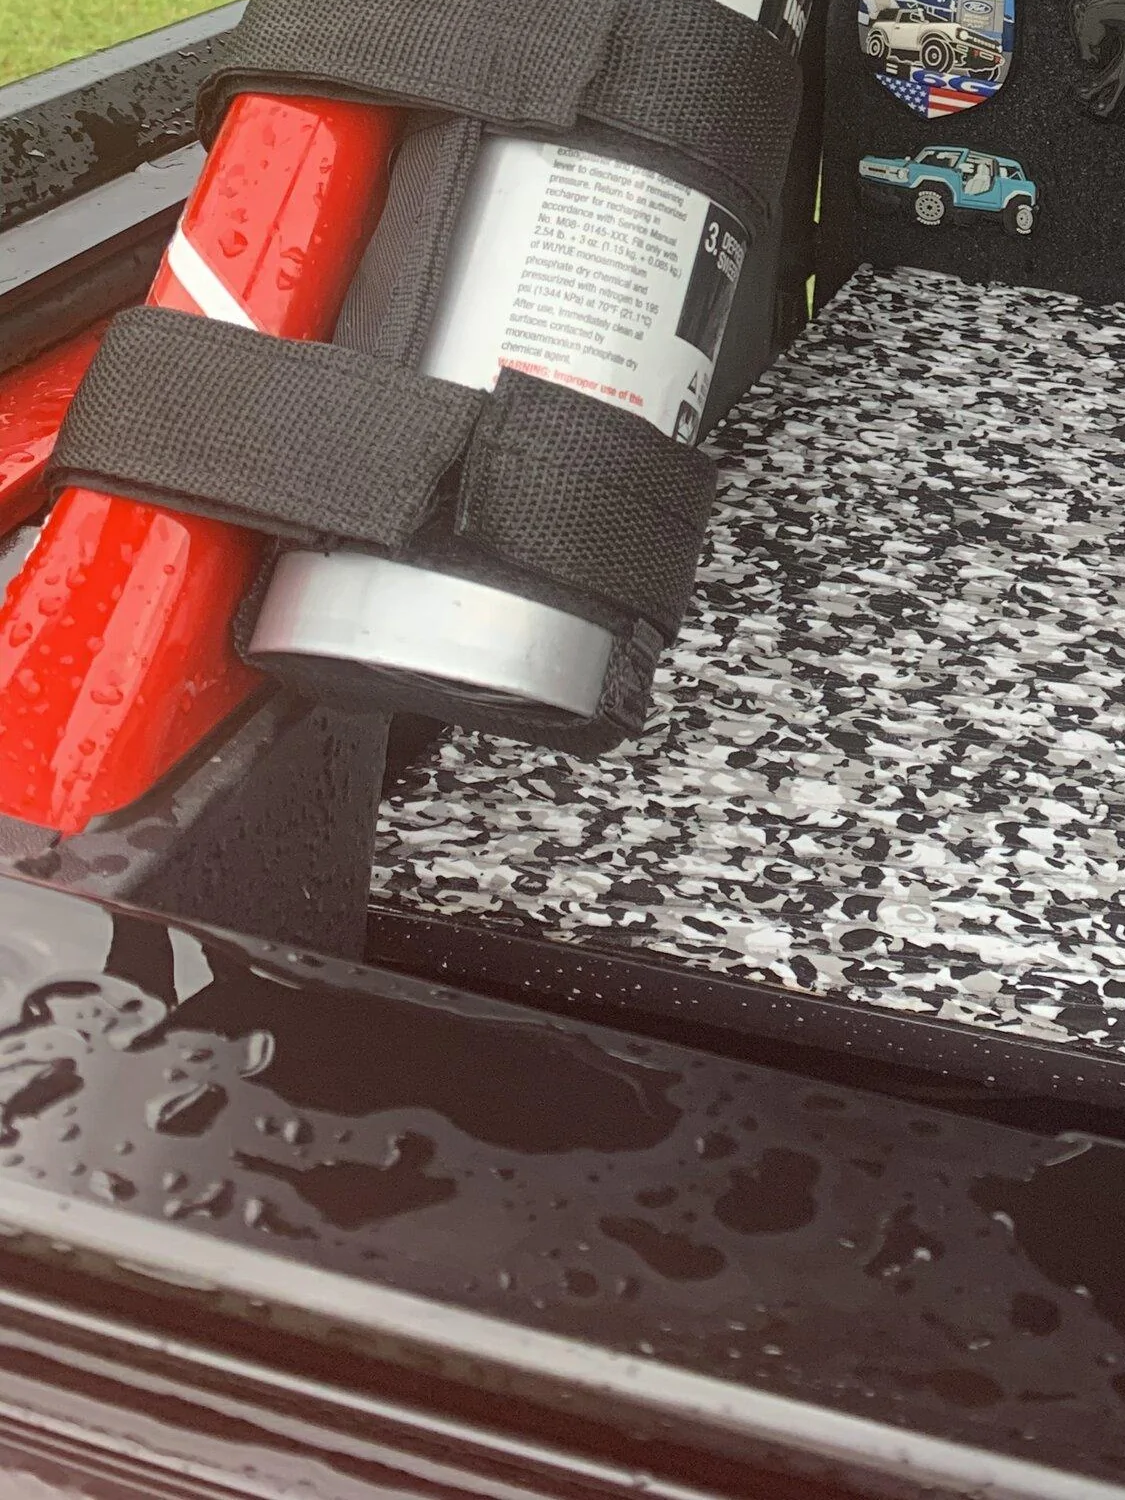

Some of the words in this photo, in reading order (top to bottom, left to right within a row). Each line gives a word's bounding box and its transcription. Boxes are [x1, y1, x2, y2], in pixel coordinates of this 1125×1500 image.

[553, 160, 575, 172] lever
[577, 164, 587, 174] to
[589, 167, 632, 186] discharge
[646, 184, 685, 207] remaining
[594, 181, 623, 197] Return
[626, 190, 634, 200] to
[636, 196, 647, 205] an
[648, 199, 688, 222] authorized
[542, 200, 594, 219] accordance
[596, 213, 616, 225] with
[618, 217, 648, 235] Service
[650, 228, 677, 247] Manual
[545, 187, 589, 203] recharger
[592, 196, 604, 207] for
[606, 200, 651, 224] recharging
[653, 215, 661, 225] in
[534, 225, 554, 237] 2.54
[579, 234, 585, 243] 3
[645, 243, 661, 255] only
[663, 249, 678, 262] with
[704, 222, 720, 256] 3.
[525, 254, 573, 273] phosphate
[576, 265, 590, 277] dry
[593, 269, 632, 289] chemical
[633, 283, 648, 295] and
[530, 241, 540, 249] of
[576, 250, 647, 278] monoammonium
[517, 282, 532, 294] psi
[534, 285, 561, 298] (1344
[564, 291, 584, 307] kPa)
[586, 296, 595, 306] at
[521, 269, 575, 288] pressurized
[577, 280, 596, 293] with
[599, 285, 635, 306] nitrogen
[636, 297, 643, 308] to
[509, 313, 548, 328] surfaces
[550, 321, 593, 341] contacted
[594, 332, 606, 345] by
[512, 297, 534, 310] After
[612, 323, 633, 337] clean
[634, 330, 645, 340] all
[501, 341, 542, 357] chemical
[505, 327, 581, 350] monoammonium
[583, 345, 625, 365] phosphate
[626, 358, 638, 371] dry
[554, 369, 599, 390] Improper
[600, 382, 616, 397] use
[618, 387, 628, 399] of
[629, 390, 644, 406] this
